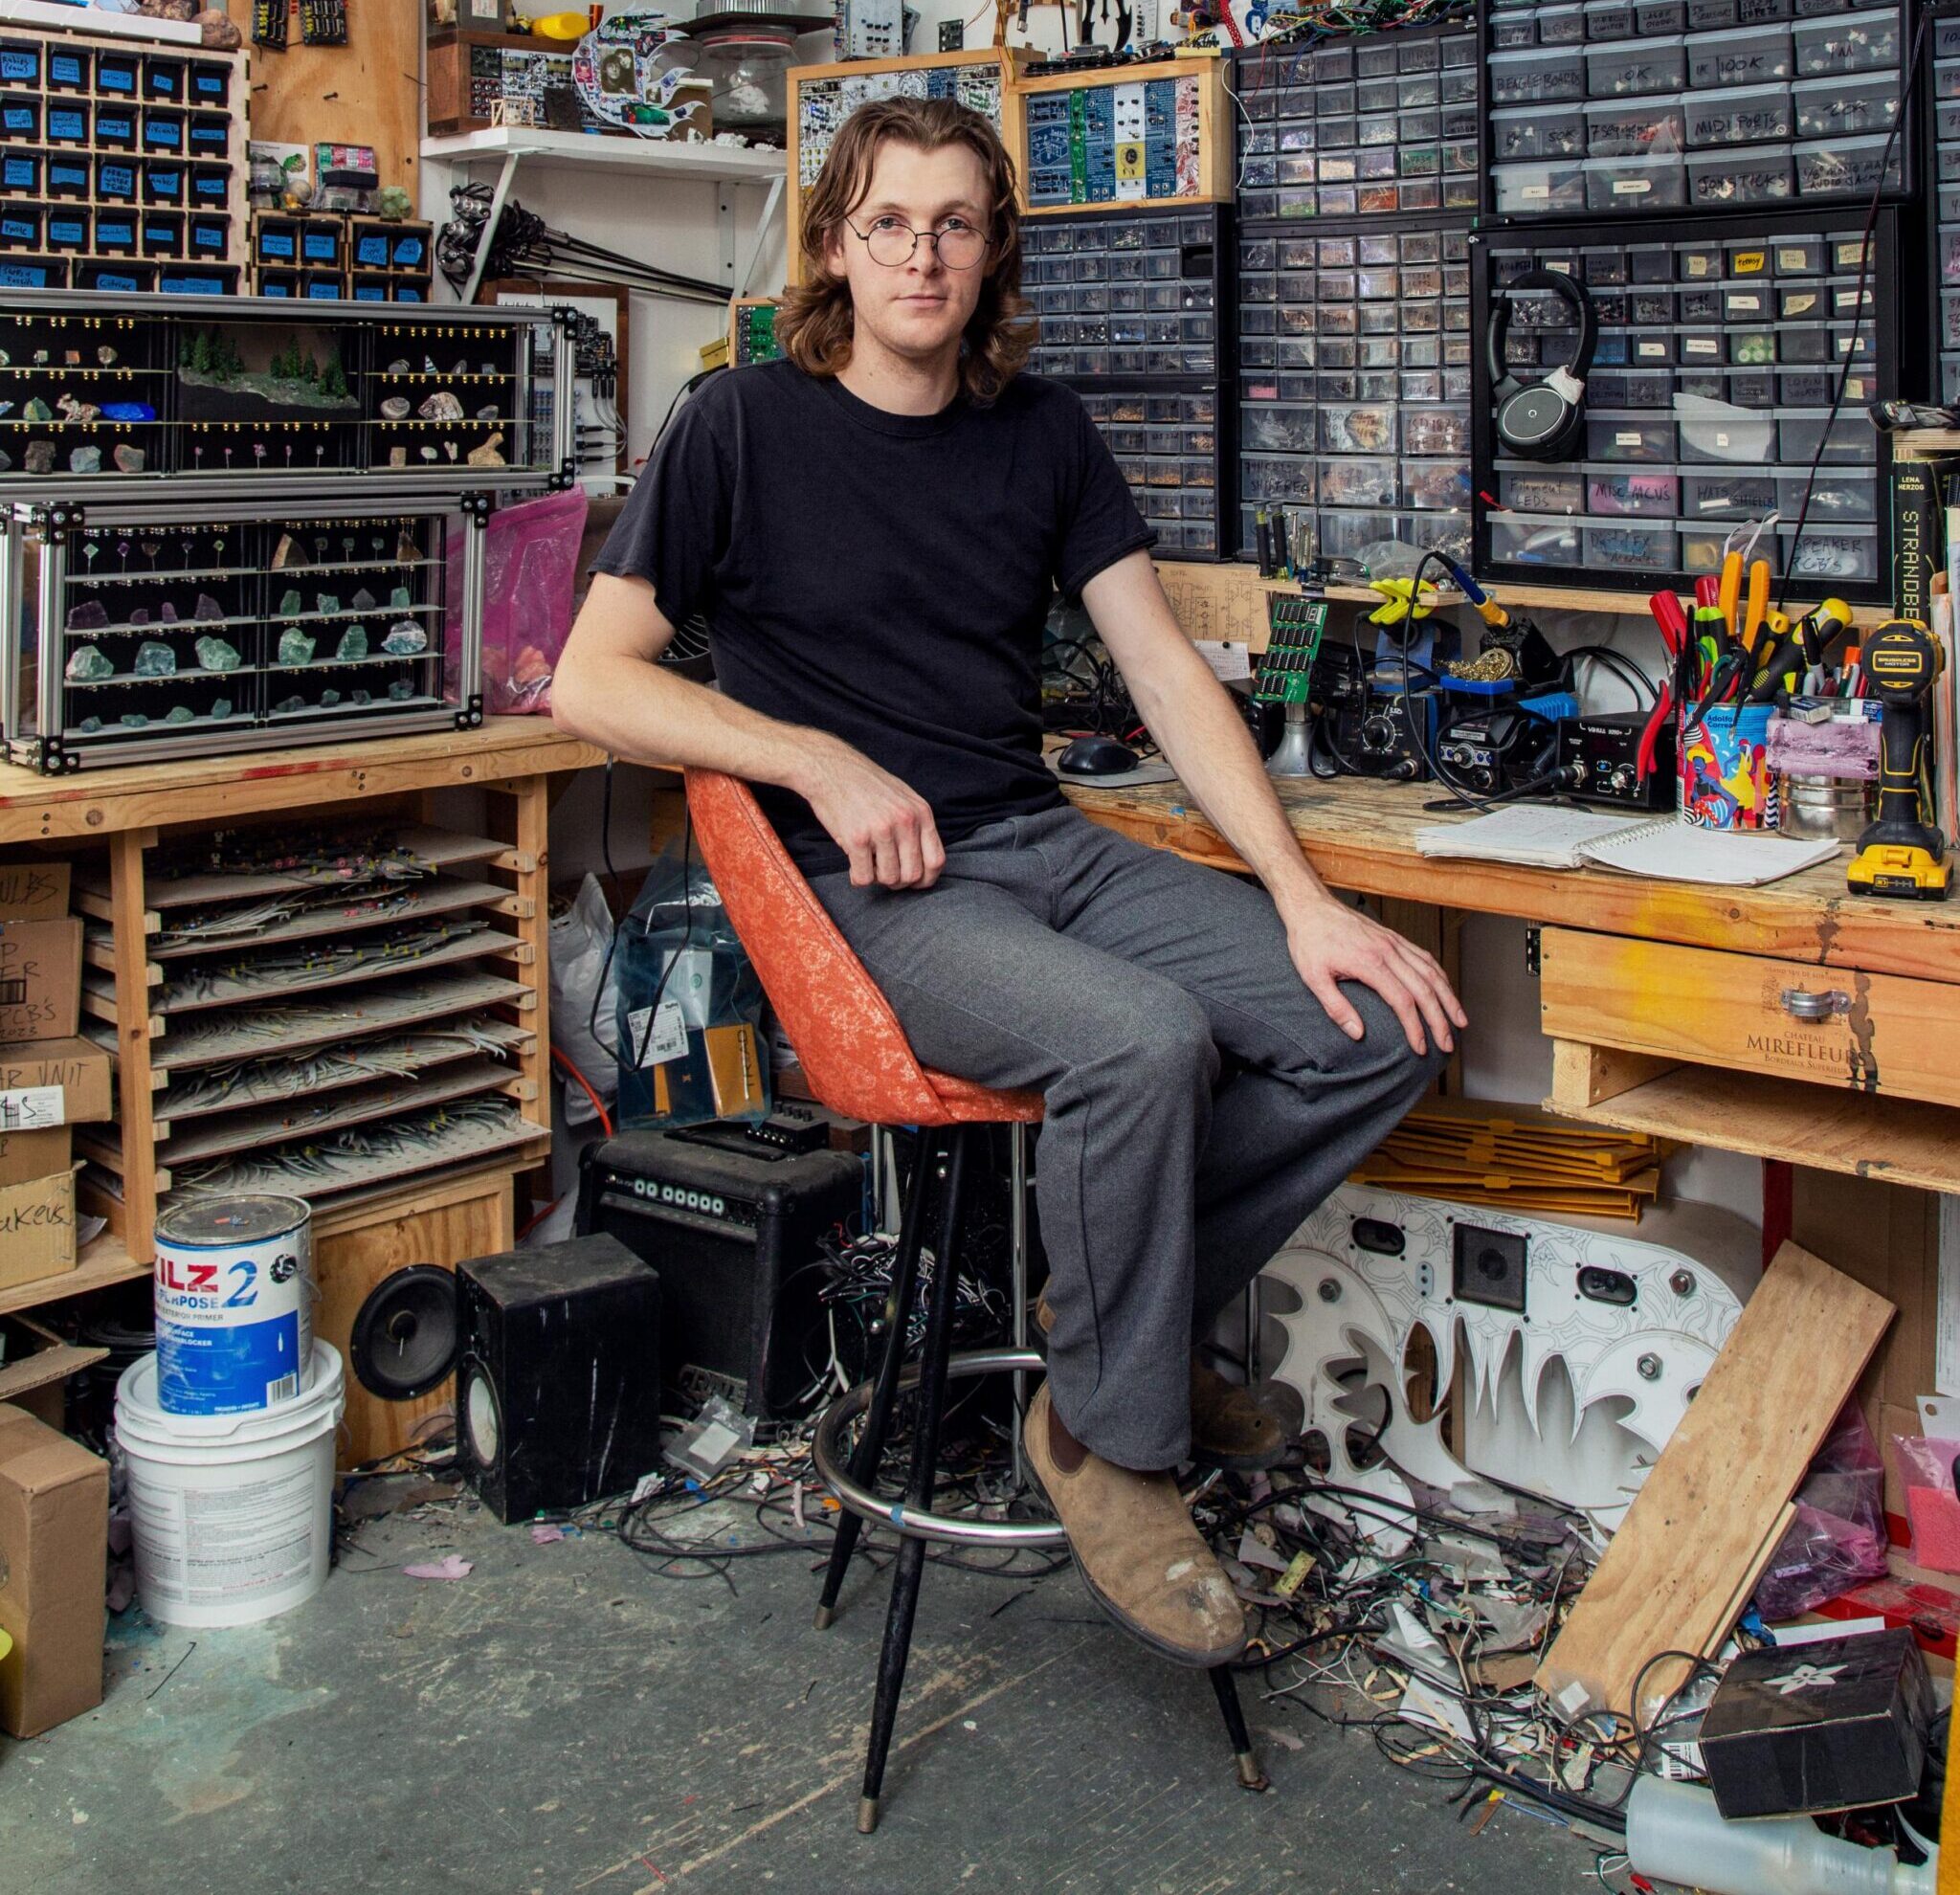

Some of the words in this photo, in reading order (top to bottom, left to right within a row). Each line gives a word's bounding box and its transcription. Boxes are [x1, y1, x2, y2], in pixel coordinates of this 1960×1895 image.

[1944, 32, 1960, 44] 10
[1695, 120, 1730, 136] MIDI
[1737, 113, 1778, 129] PORTS
[1596, 482, 1625, 498] MISC
[1903, 510, 1920, 620] STRANDBE
[1747, 1035, 1867, 1067] MIREFLEURS
[38, 1059, 89, 1087] UNIT
[156, 1255, 218, 1292] ILZ
[221, 1260, 259, 1308] 2
